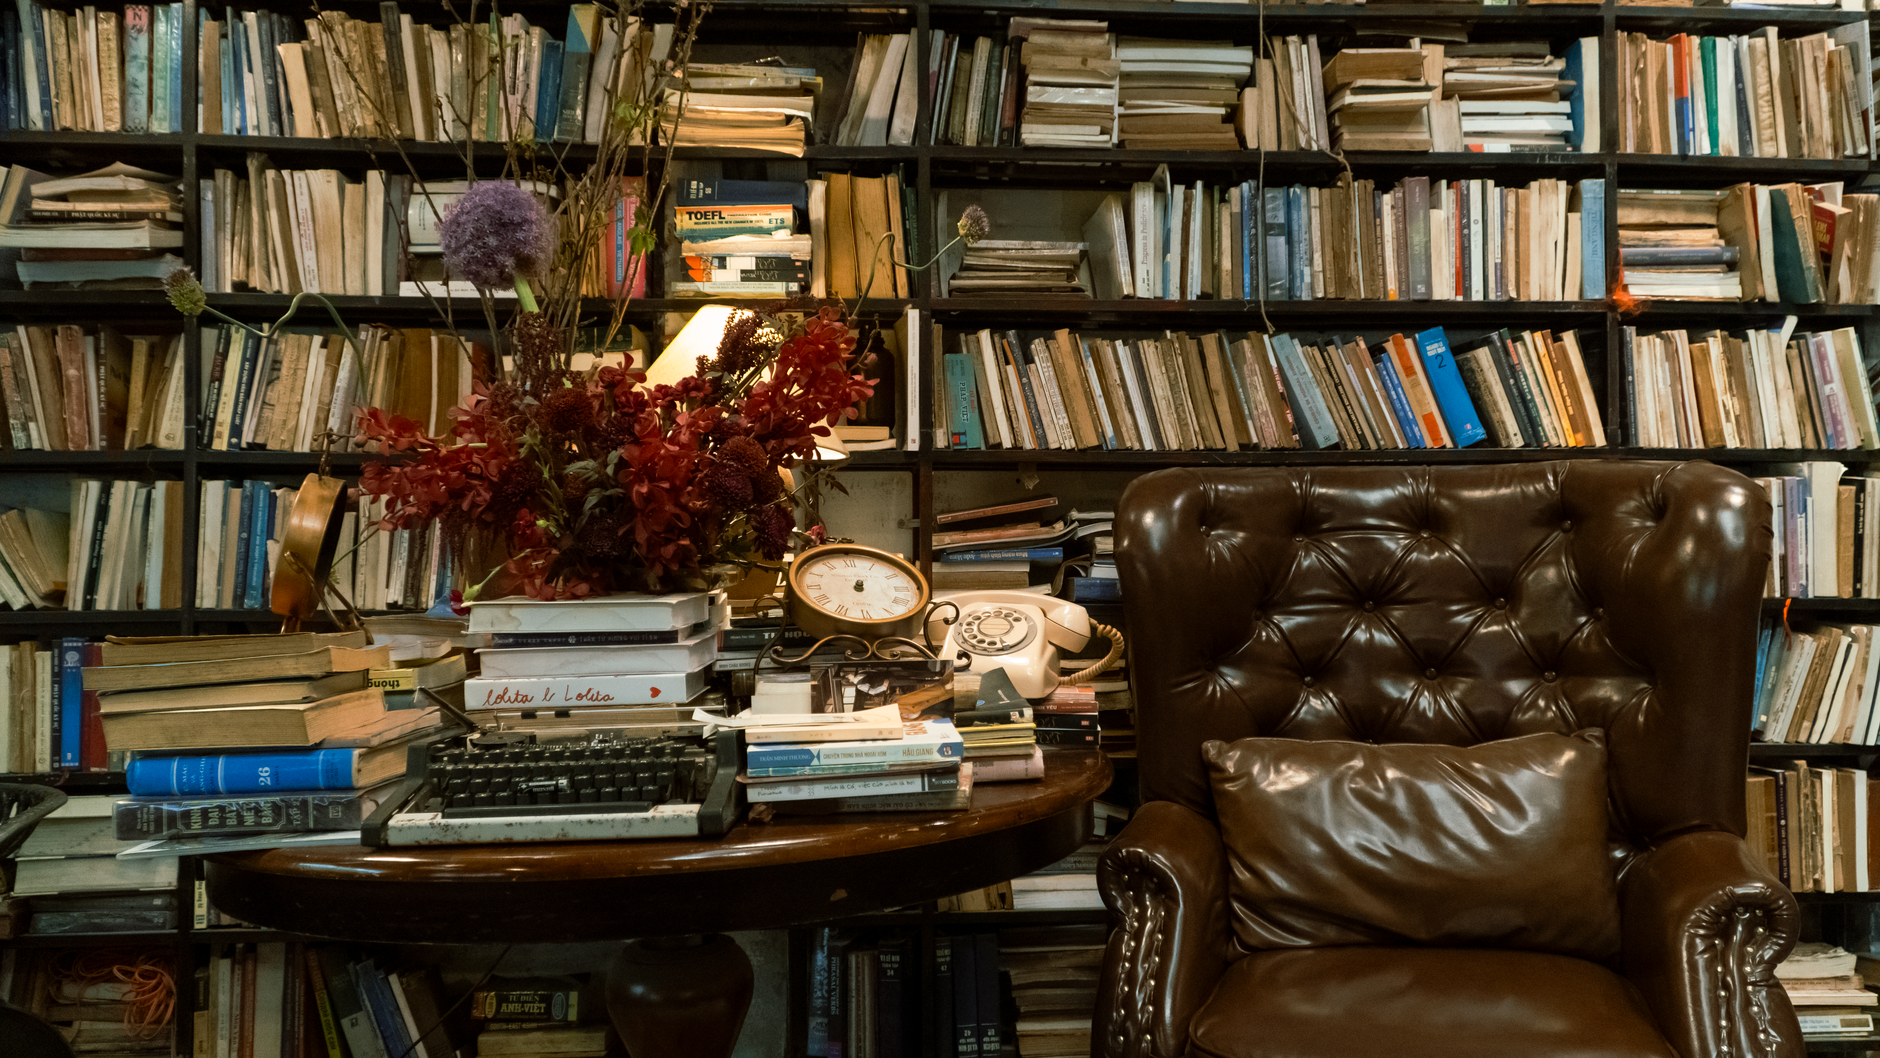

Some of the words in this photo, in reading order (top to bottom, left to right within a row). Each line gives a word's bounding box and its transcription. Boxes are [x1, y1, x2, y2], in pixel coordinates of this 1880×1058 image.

[134, 12, 142, 21] N
[686, 210, 726, 220] TOEFL
[1435, 354, 1447, 369] 2
[959, 381, 969, 402] PHÁP
[843, 559, 857, 568] XII
[564, 684, 615, 703] Lolita
[759, 754, 773, 762] TRẦN
[902, 748, 916, 757] HẬU
[916, 748, 934, 756] GIANG
[257, 766, 271, 786] 26
[190, 803, 202, 830] KINH
[208, 808, 221, 826] ĐẠI
[223, 806, 237, 827] BÁT
[238, 804, 255, 827] NIẾT
[257, 804, 273, 825] BÀN
[500, 1001, 546, 1015] ANH-VIỆT
